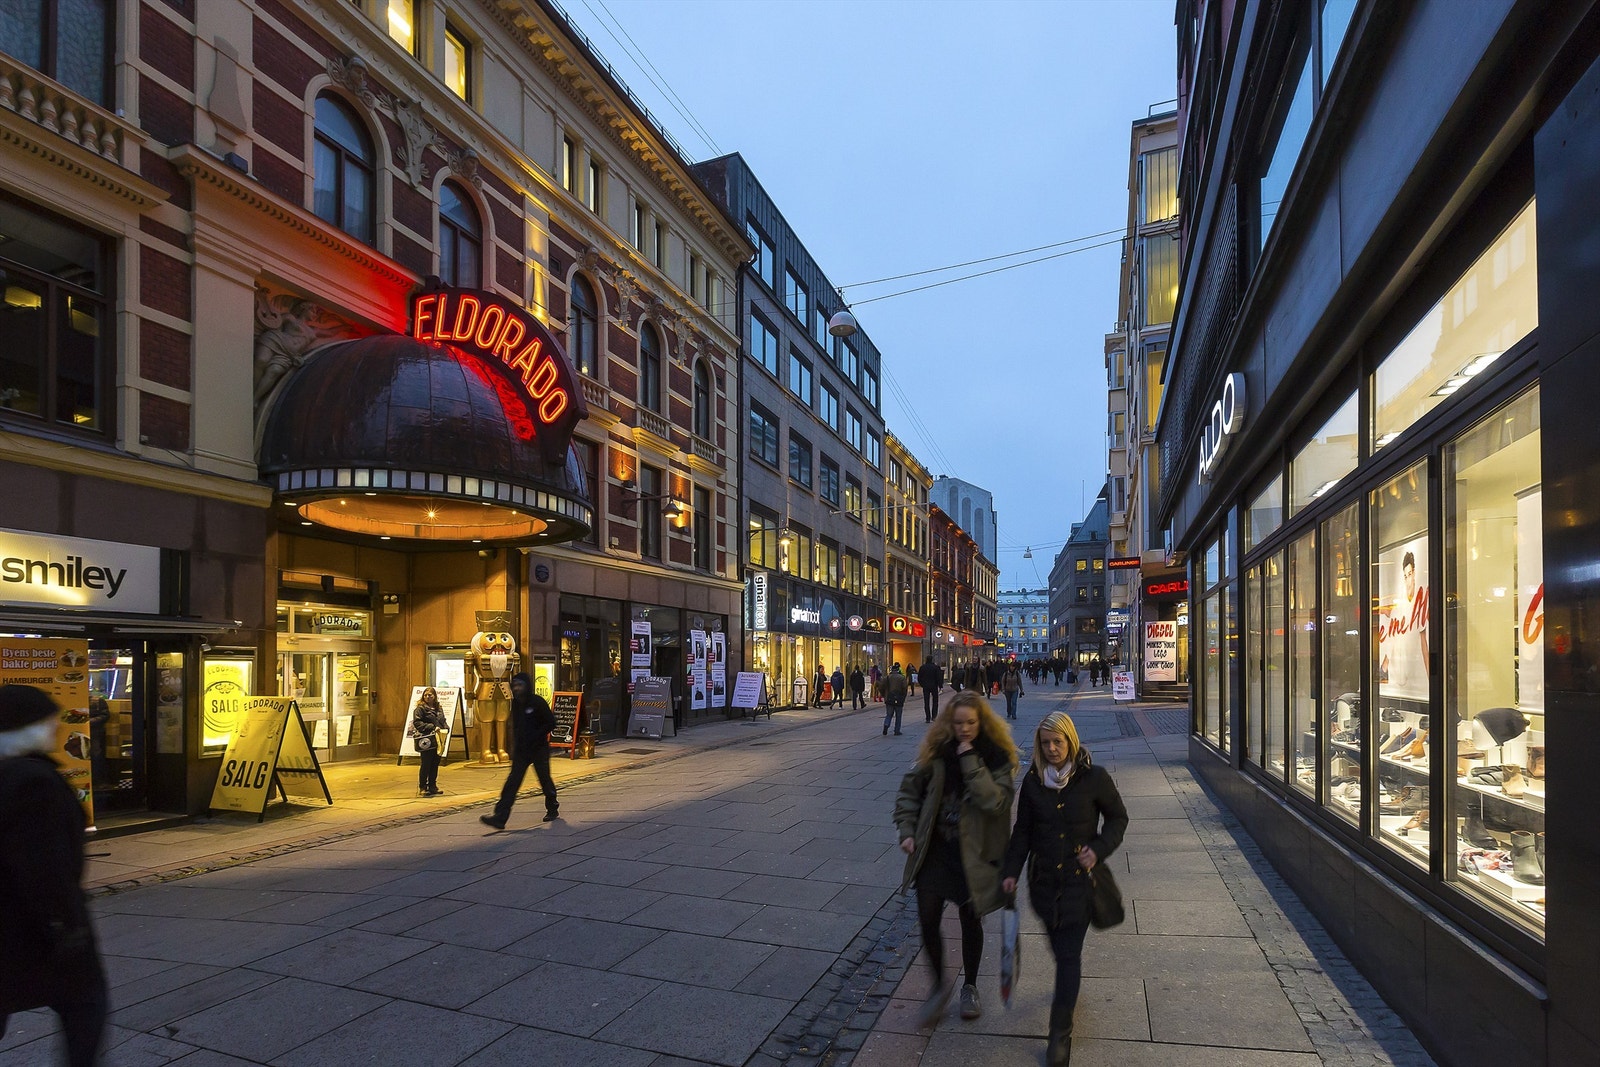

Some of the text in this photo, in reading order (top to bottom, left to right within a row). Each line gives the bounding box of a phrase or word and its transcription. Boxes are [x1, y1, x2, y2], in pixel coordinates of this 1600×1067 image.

[413, 293, 568, 424] ELDORADO
[1198, 372, 1237, 486] ALDO
[1, 555, 128, 599] smiley
[754, 575, 768, 629] ginatricot
[307, 615, 360, 631] ELDORADO
[1388, 616, 1410, 638] me
[2, 648, 56, 659] Byens beste
[2, 659, 58, 670] bakte potet!
[211, 699, 239, 713] SALG
[243, 699, 285, 713] ELDORADO
[221, 759, 269, 789] SALG
